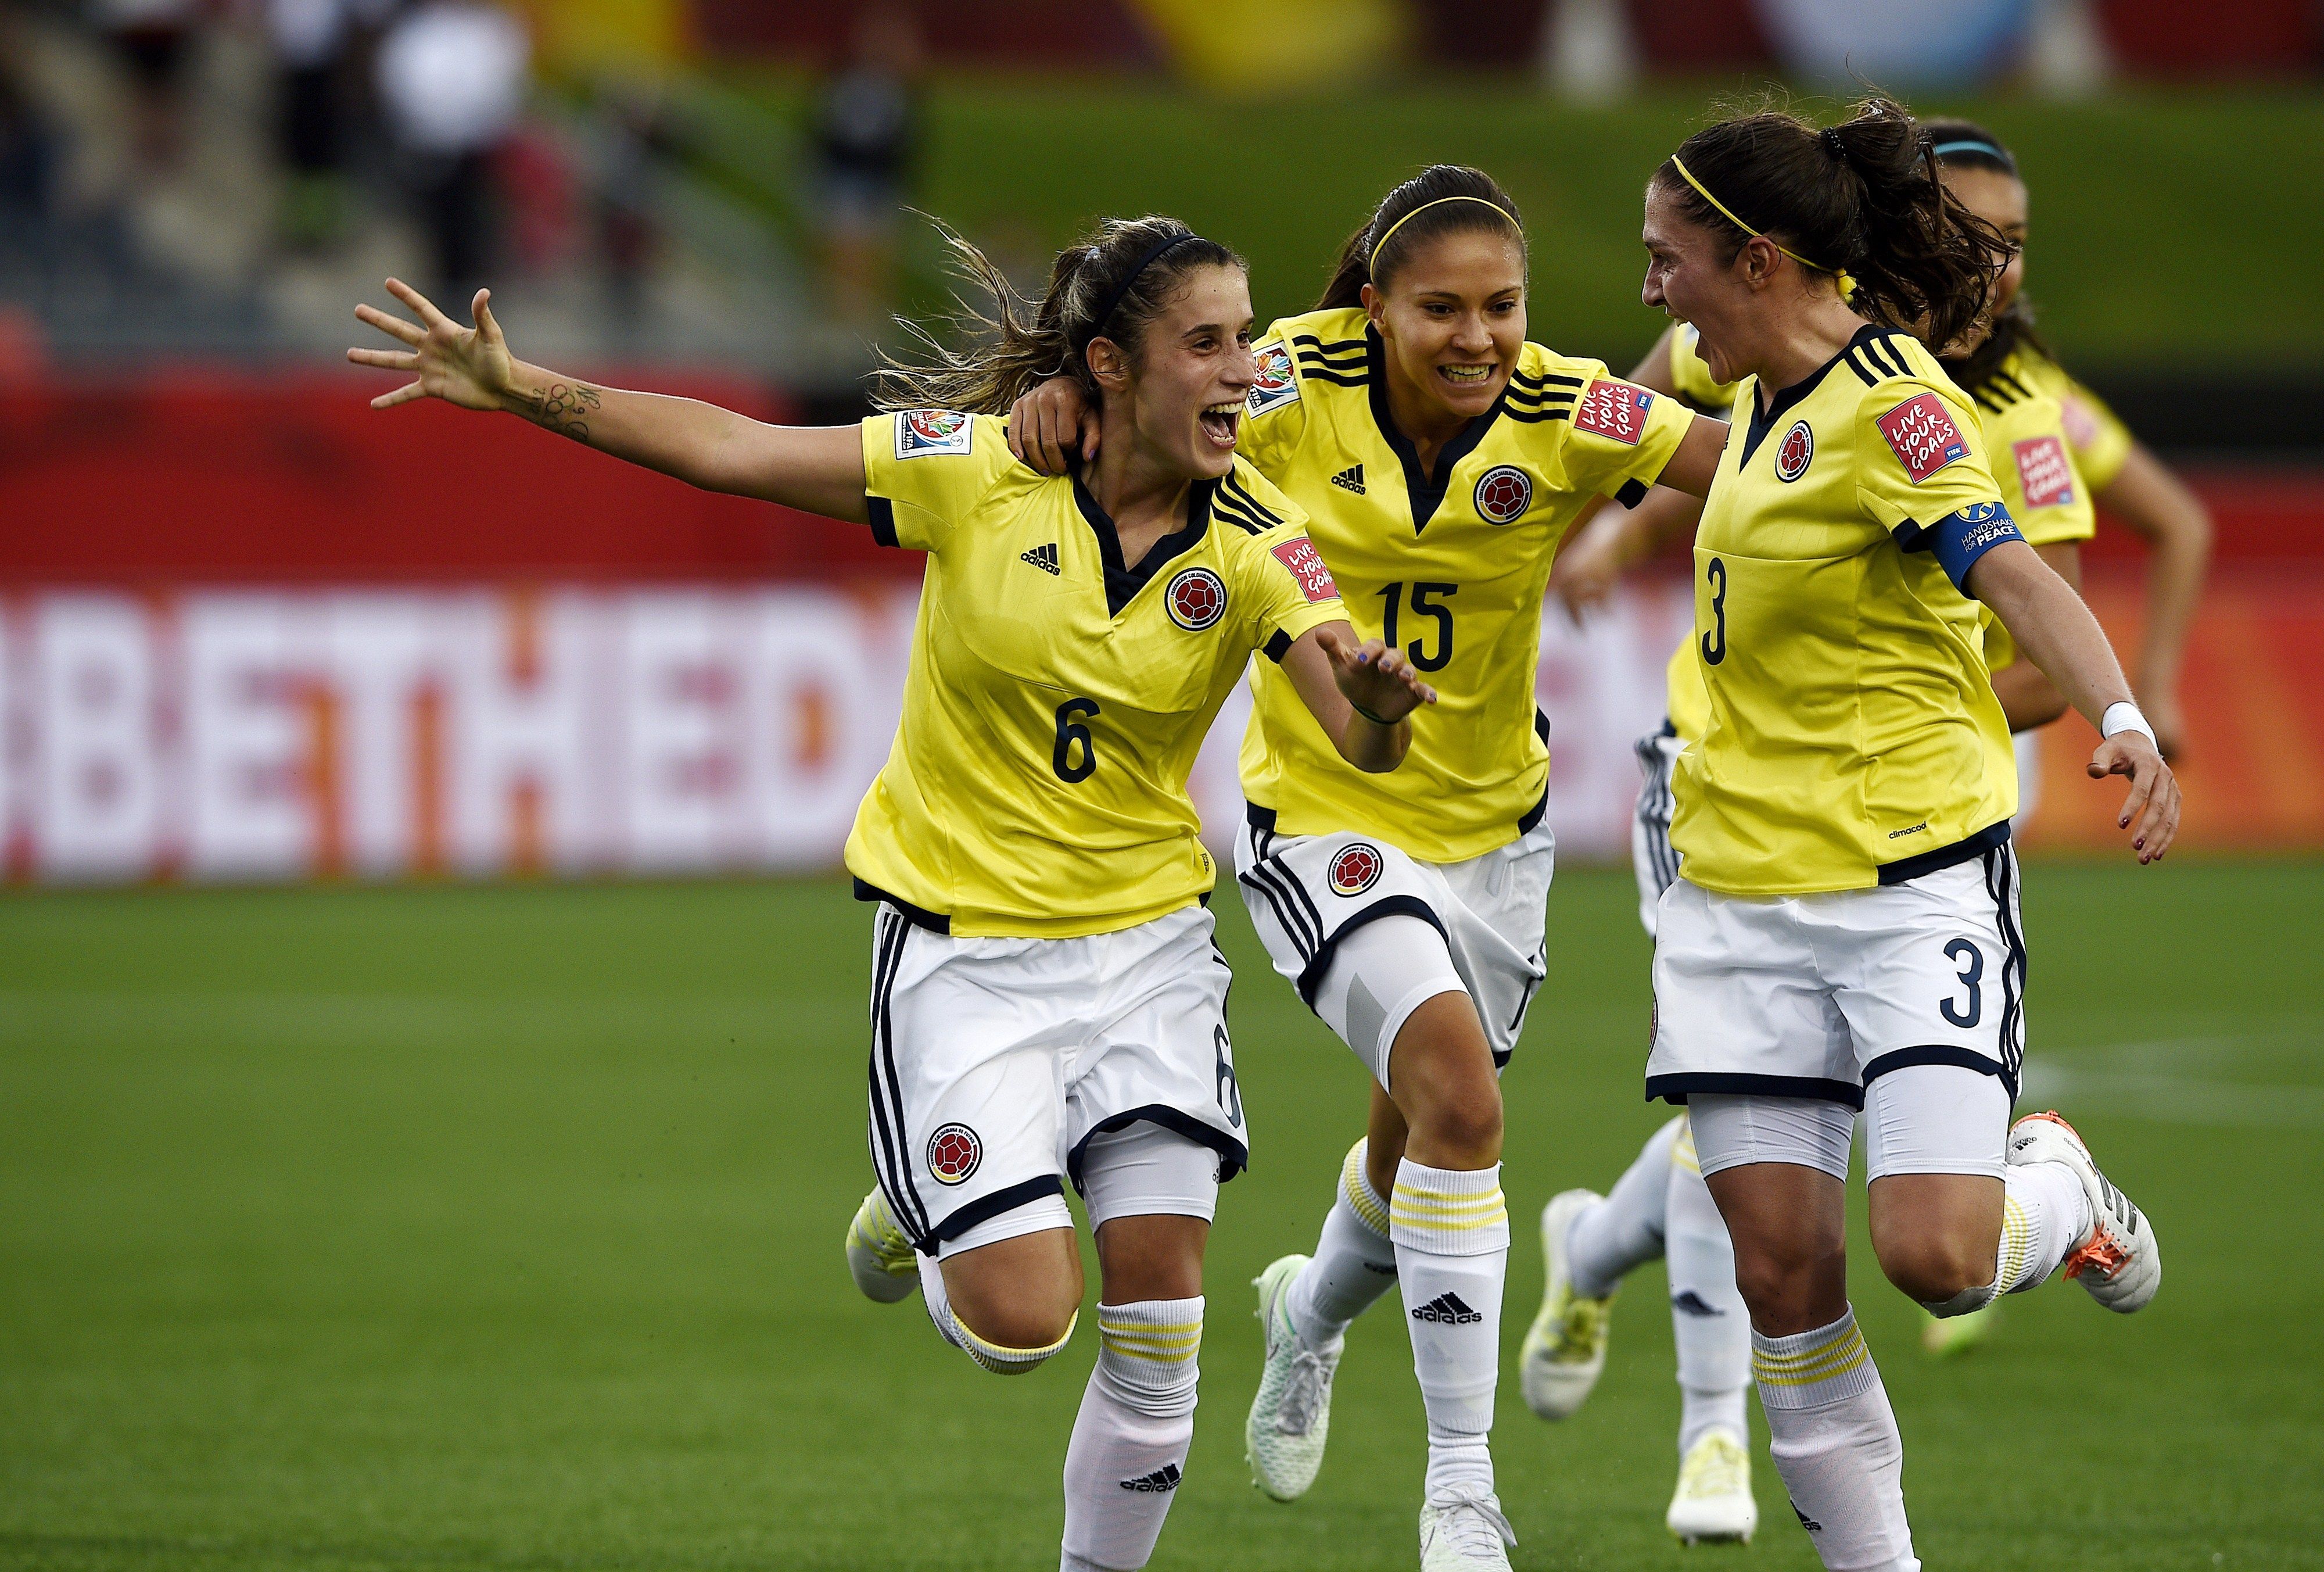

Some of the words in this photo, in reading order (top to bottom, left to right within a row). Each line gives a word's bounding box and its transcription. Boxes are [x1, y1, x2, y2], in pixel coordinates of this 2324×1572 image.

[1250, 388, 1262, 407] FIFA
[1581, 391, 1597, 425] LIVE
[1598, 386, 1615, 429] YOUR
[1616, 386, 1633, 435] GOALS
[1892, 404, 1926, 442] LIVE
[1899, 414, 1945, 456] YOUR
[1911, 422, 1954, 470] GOALS
[1946, 447, 1961, 457] FIFA
[1331, 475, 1366, 495] adidas
[1961, 518, 2015, 547] HANDSHAKE
[1964, 540, 1977, 553] FOR
[1977, 525, 2016, 547] PEACE
[1020, 552, 1061, 576] adidas
[1287, 543, 1315, 565] LIVE
[1375, 582, 1458, 672] 15
[1702, 557, 1726, 665] 3
[1052, 697, 1101, 783] 6
[1940, 938, 1984, 1029] 3
[1213, 1023, 1241, 1129] 6
[1411, 1309, 1482, 1324] adidas
